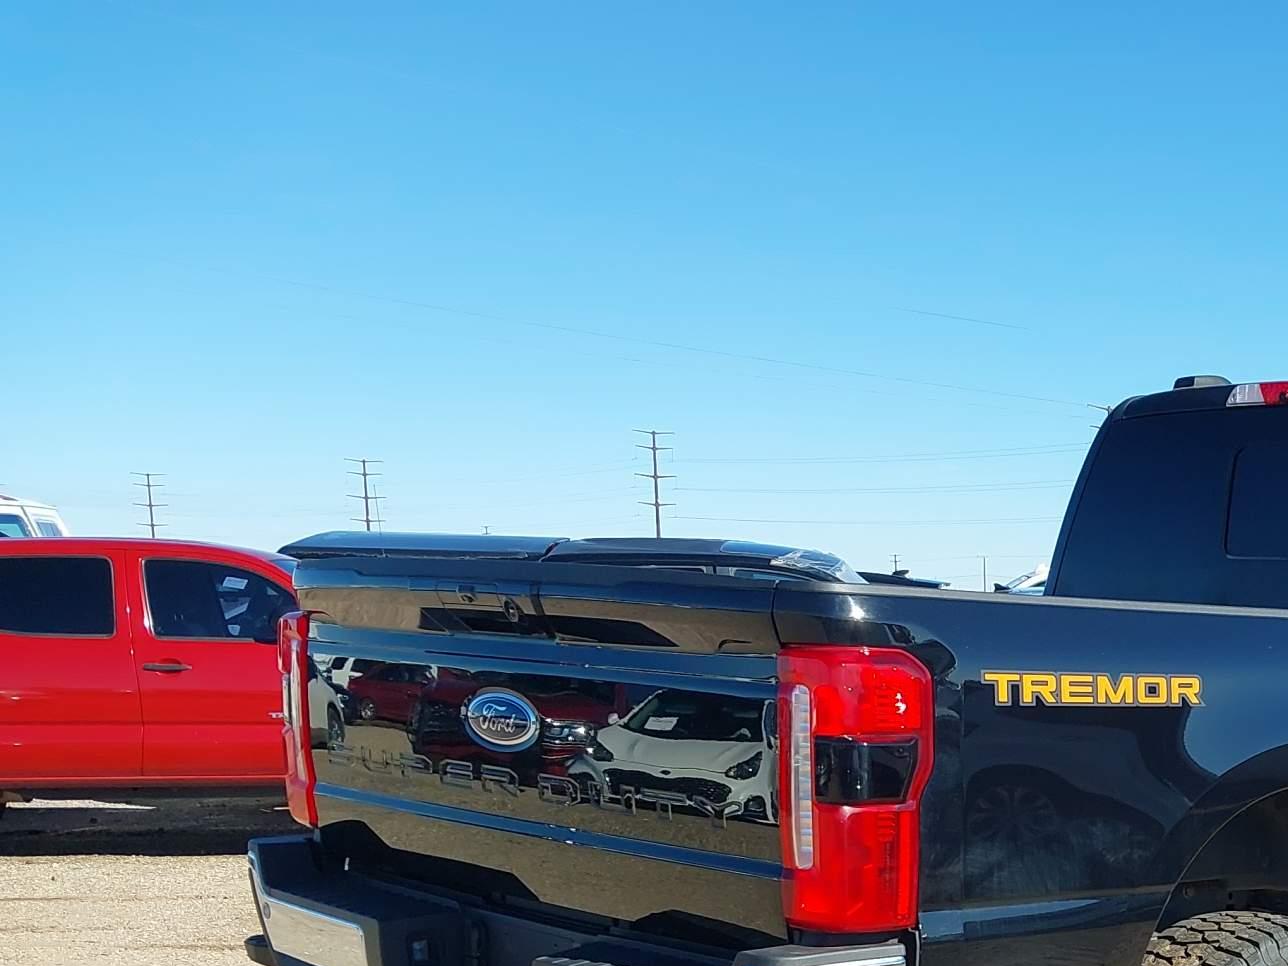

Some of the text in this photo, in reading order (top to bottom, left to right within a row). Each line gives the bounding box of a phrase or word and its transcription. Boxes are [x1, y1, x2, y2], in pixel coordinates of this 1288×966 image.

[982, 671, 1204, 706] TREMOR
[480, 703, 516, 733] Ford
[328, 744, 744, 830] SUPER DUTY
